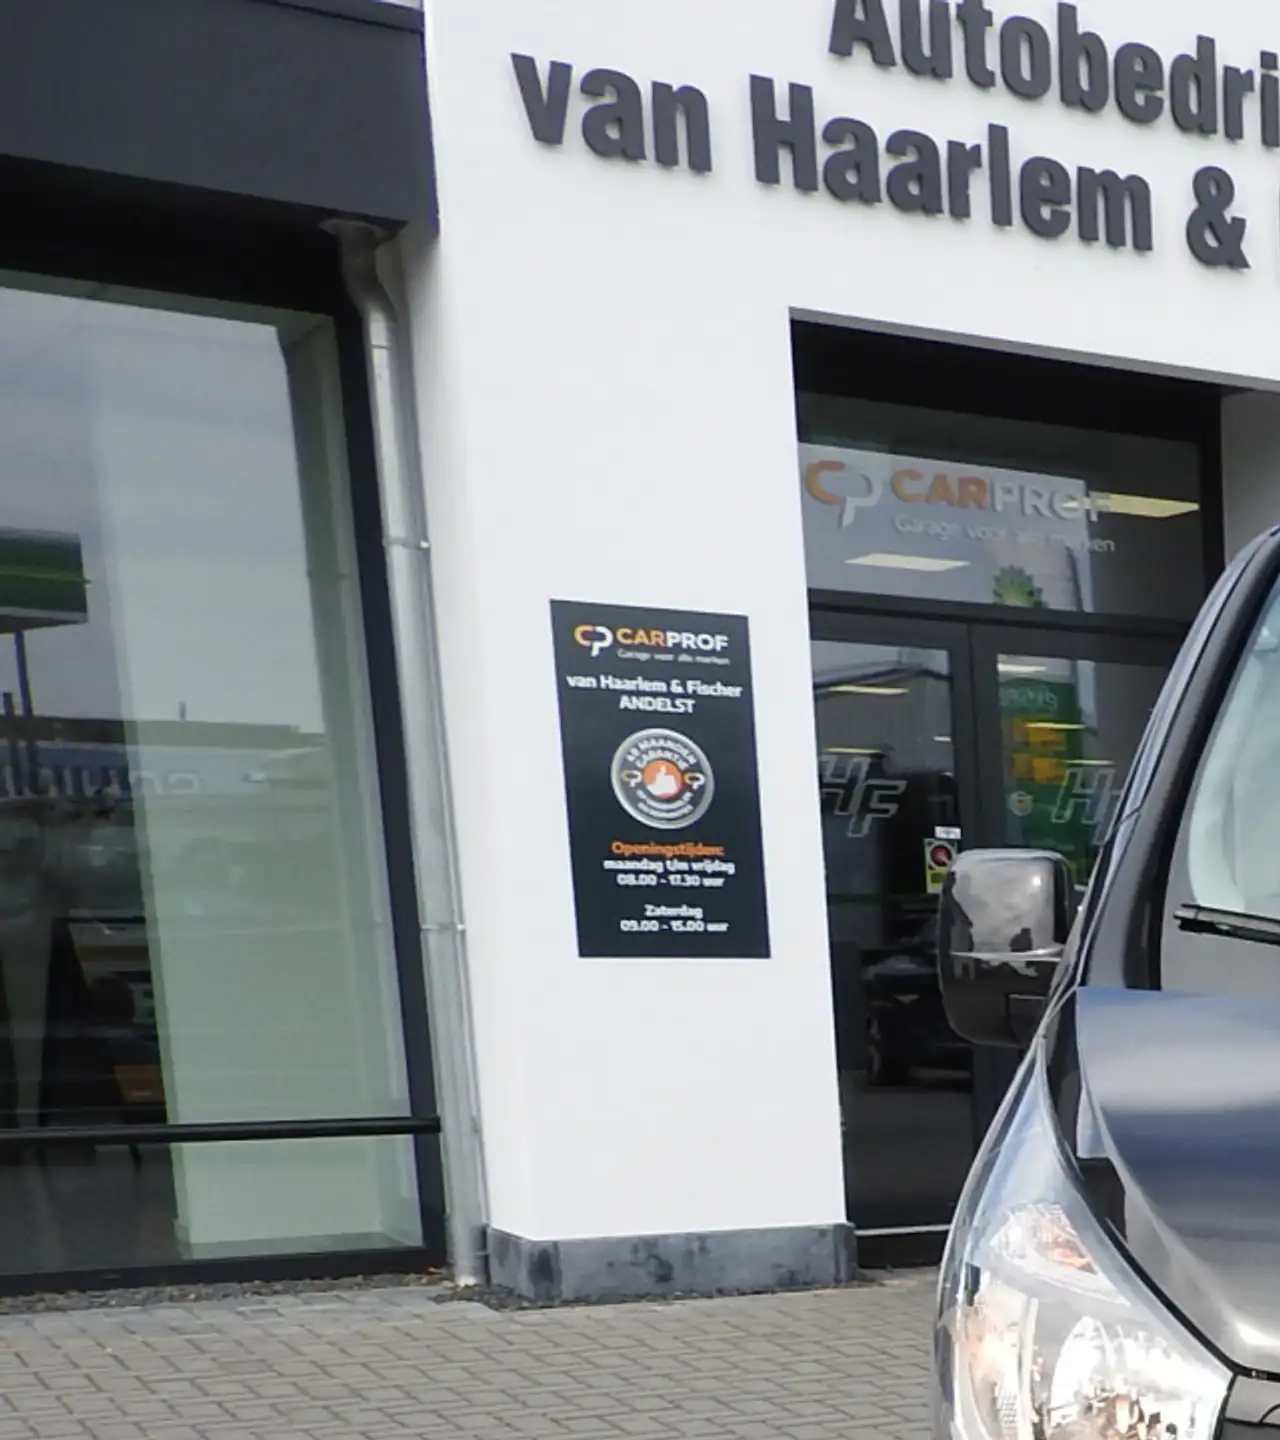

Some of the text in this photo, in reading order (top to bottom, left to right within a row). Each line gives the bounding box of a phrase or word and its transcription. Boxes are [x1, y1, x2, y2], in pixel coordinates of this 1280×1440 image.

[511, 53, 713, 174] van
[750, 74, 1153, 253] Haarlem
[1186, 166, 1250, 271] &
[616, 627, 730, 652] CARPROF
[566, 674, 743, 698] van Haarlem & Fischer
[619, 695, 696, 714] ANDELST
